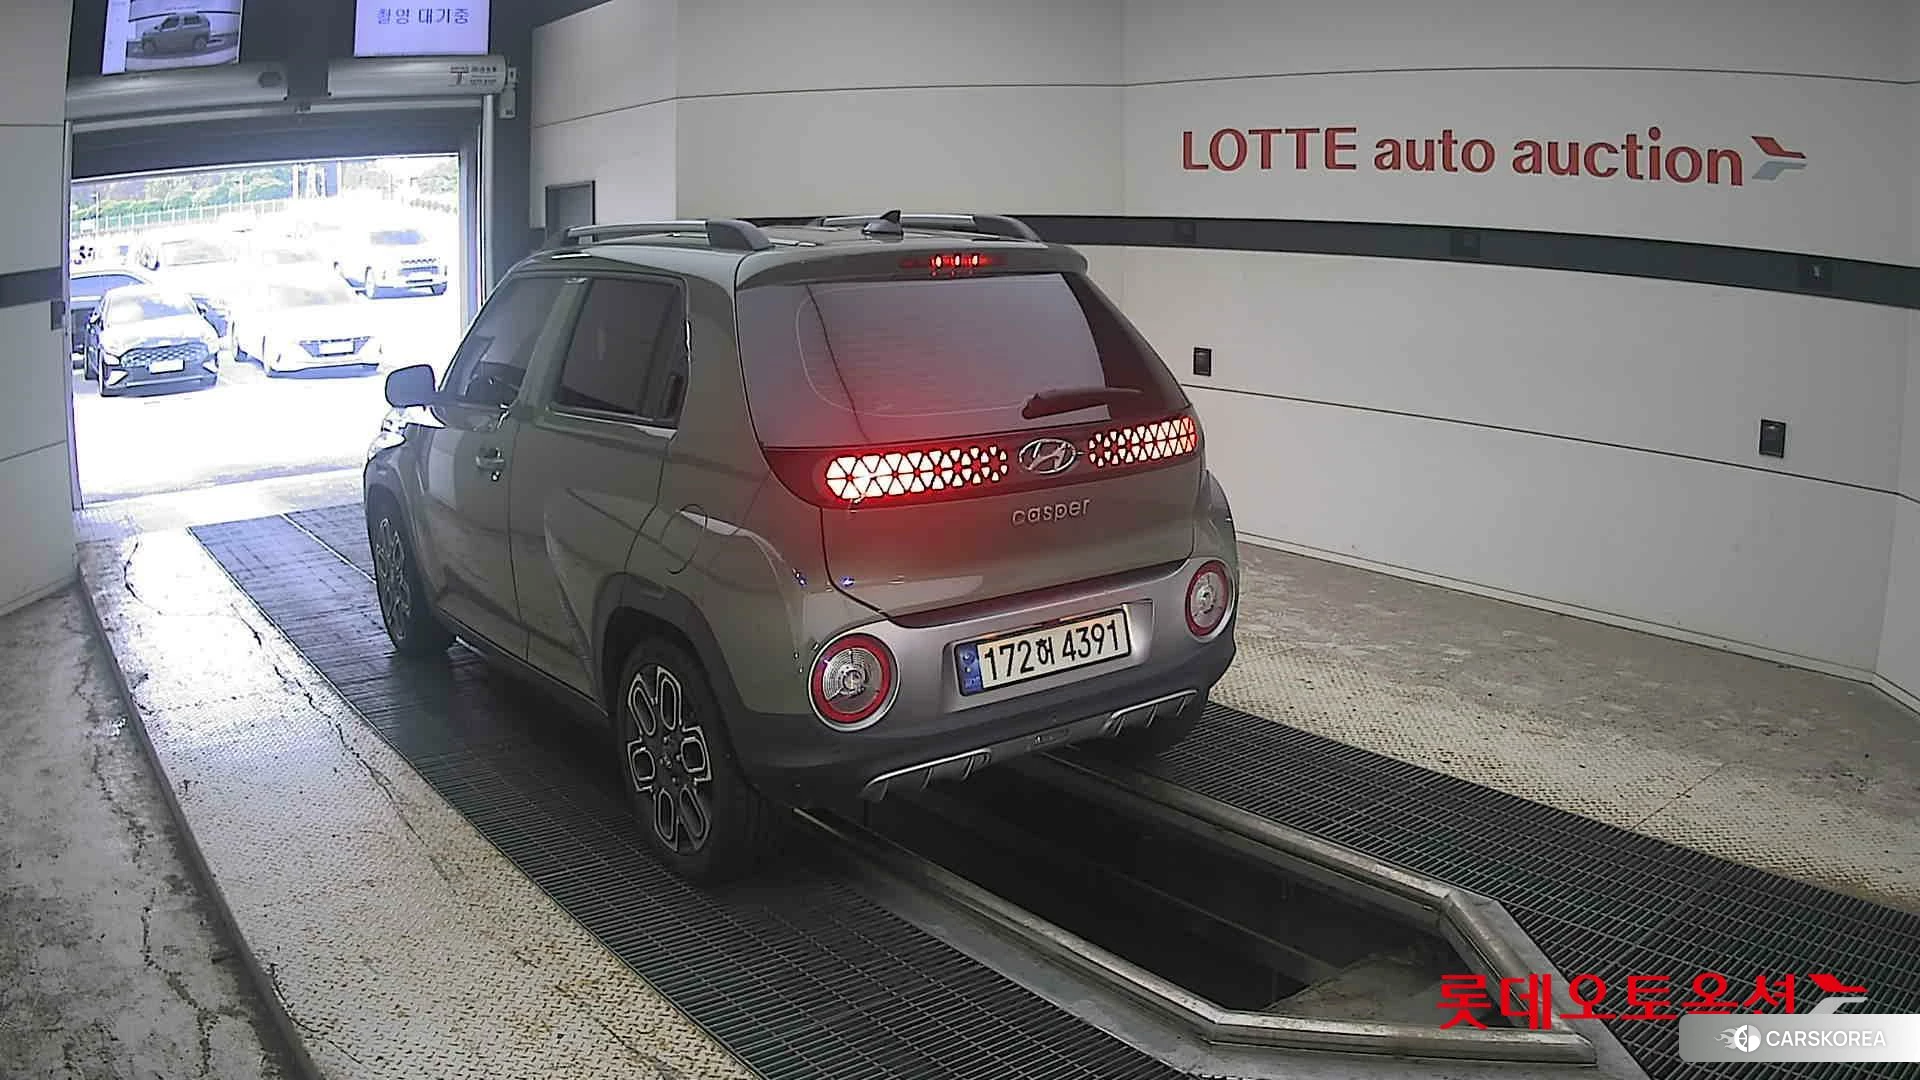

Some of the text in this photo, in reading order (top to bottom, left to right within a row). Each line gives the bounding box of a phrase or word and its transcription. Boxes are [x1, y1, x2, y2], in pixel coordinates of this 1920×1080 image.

[418, 8, 469, 25] 대기중
[1182, 126, 1743, 186] LOTTE auto auction
[1012, 498, 1091, 525] casper
[1062, 620, 1120, 661] 4391
